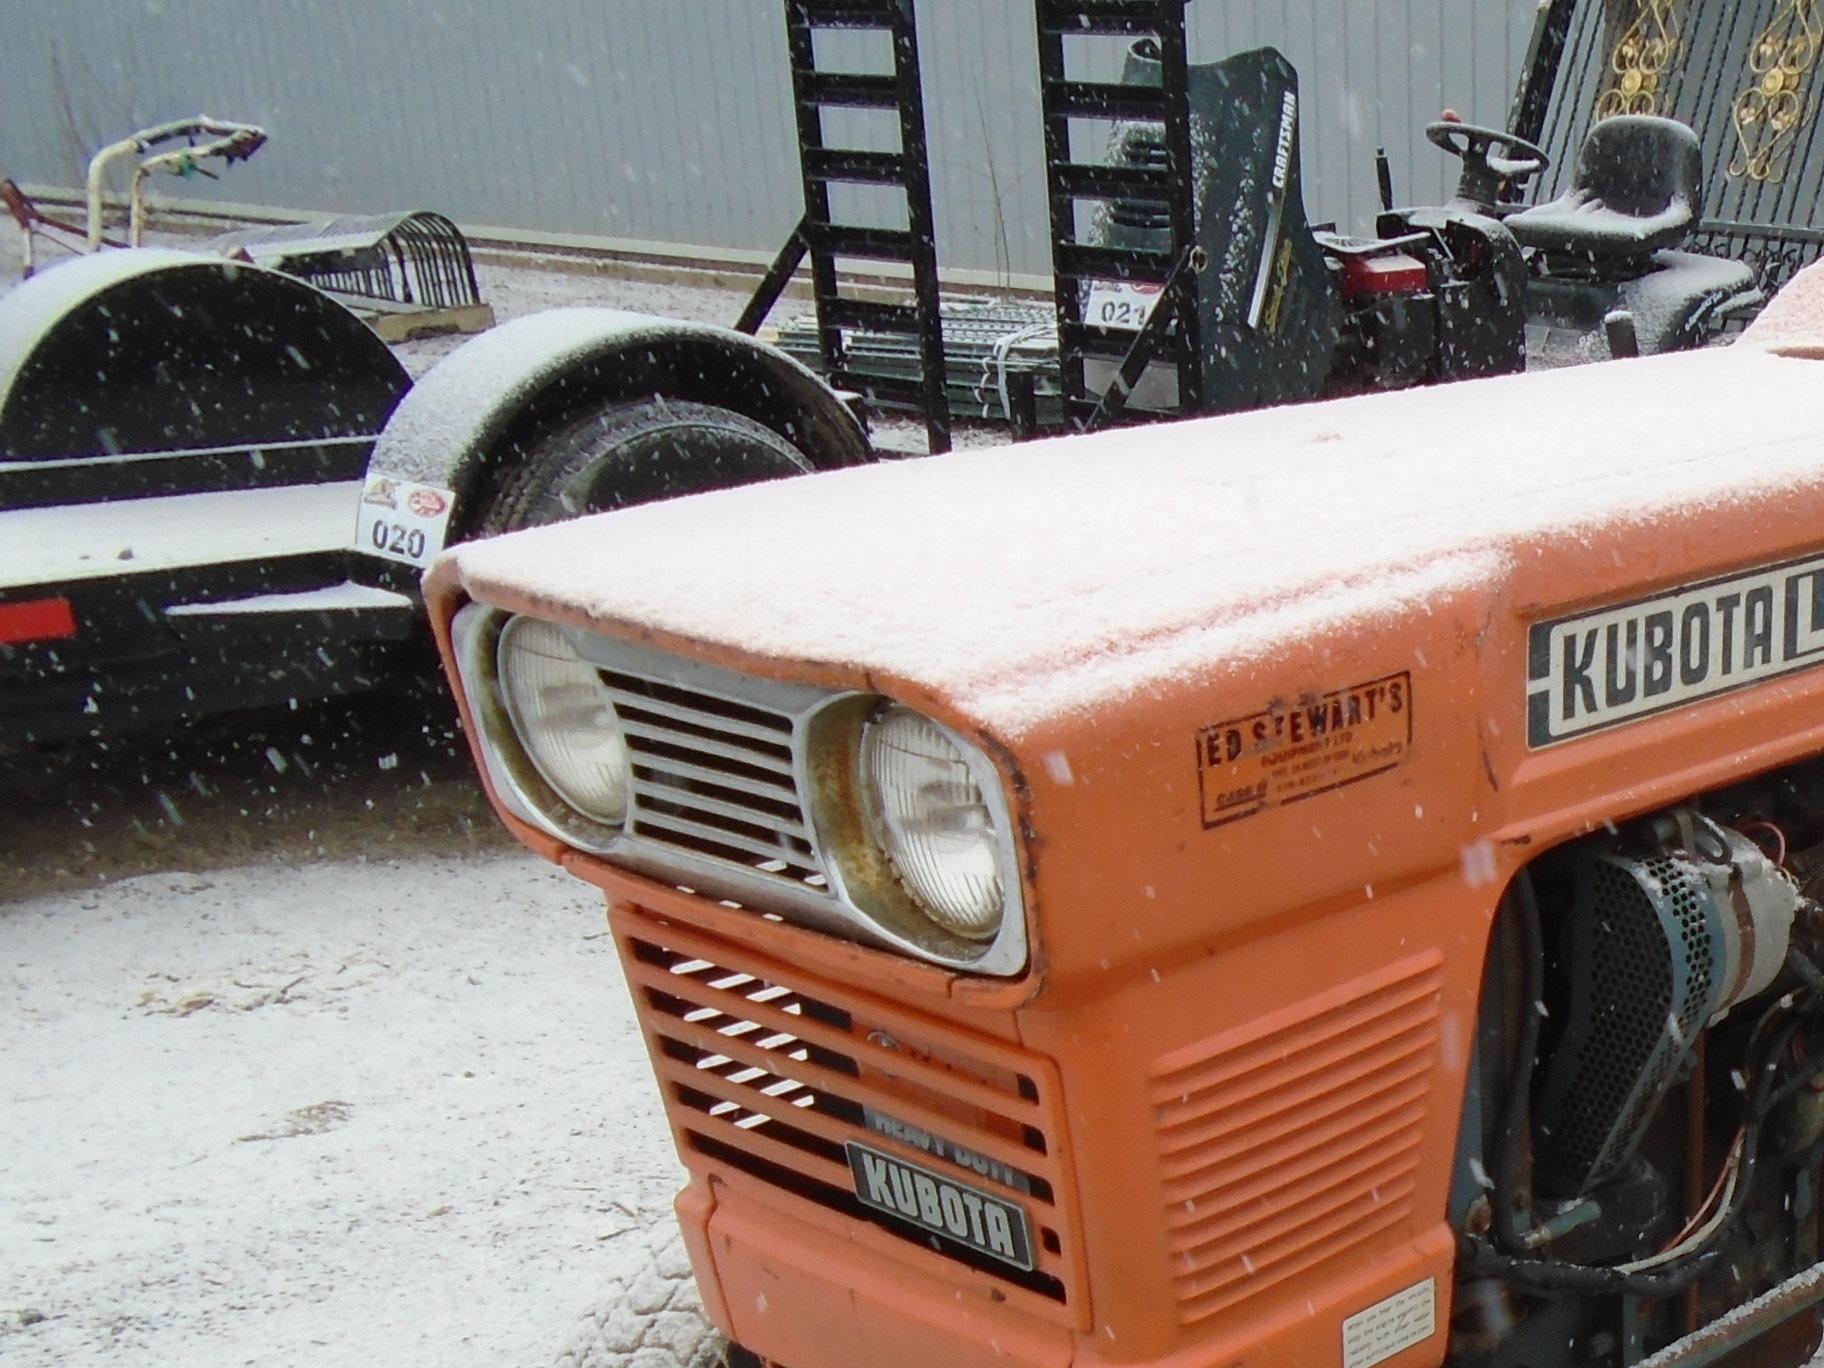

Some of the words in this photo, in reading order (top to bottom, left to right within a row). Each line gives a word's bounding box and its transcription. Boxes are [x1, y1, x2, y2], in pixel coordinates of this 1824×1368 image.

[1272, 90, 1297, 189] CRAFTSMAN
[372, 519, 425, 559] 020
[1562, 585, 1773, 721] KUBOTA
[862, 1152, 1016, 1258] KUBOTA
